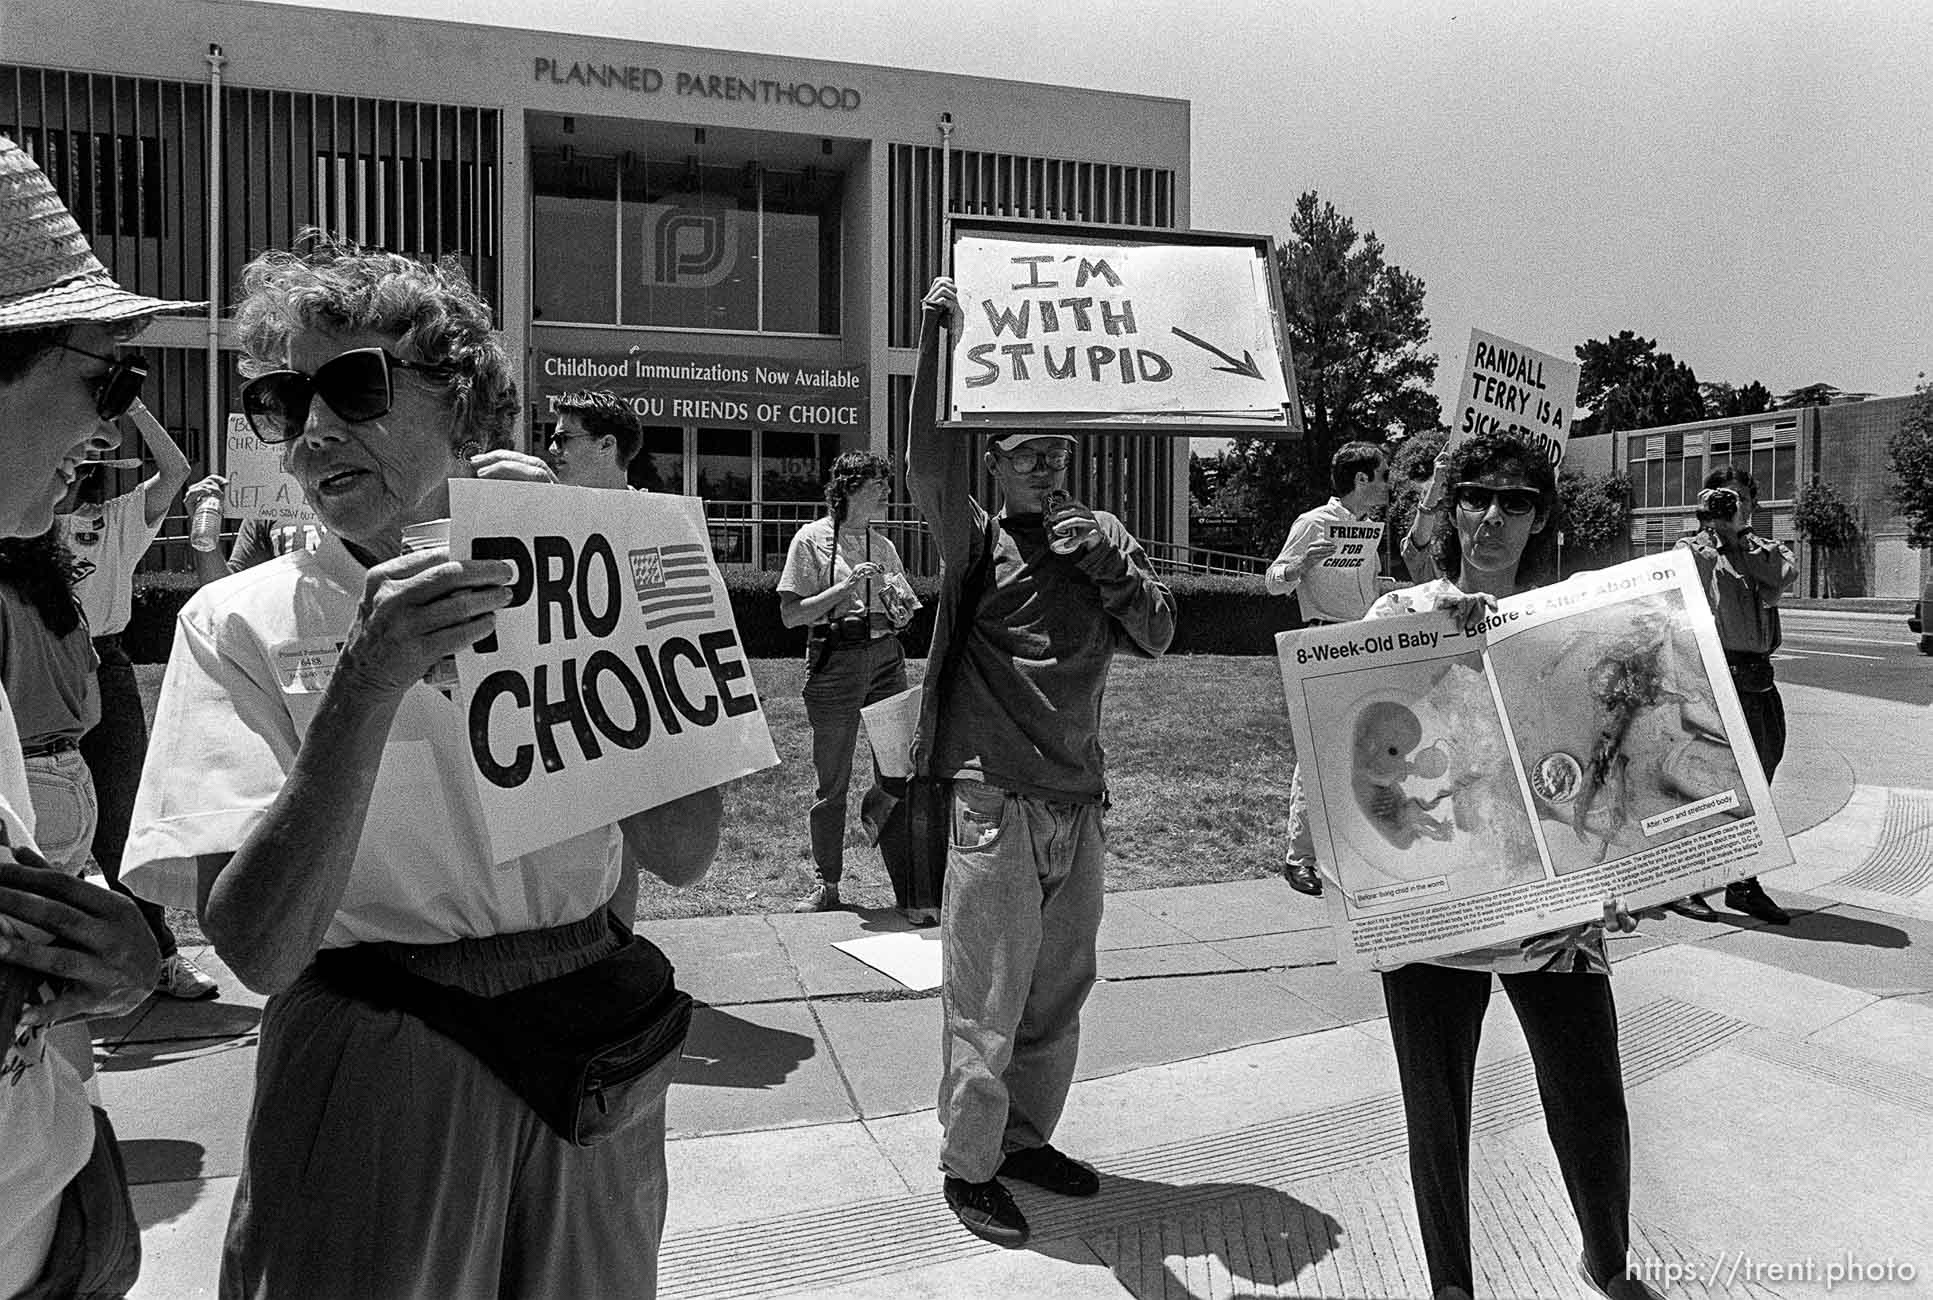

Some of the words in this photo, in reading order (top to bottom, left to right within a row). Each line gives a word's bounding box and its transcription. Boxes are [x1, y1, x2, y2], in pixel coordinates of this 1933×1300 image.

[534, 56, 664, 94] PLANNED
[675, 71, 861, 111] PARENTHOOD
[1011, 255, 1124, 290] I'M
[981, 297, 1138, 339] WITH
[544, 357, 629, 377] Childhood
[636, 360, 749, 383] Immunizations
[755, 367, 790, 385] Now
[794, 369, 860, 388] Available
[965, 343, 1173, 389] STUPID
[1474, 341, 1546, 390] RANDALL
[673, 398, 748, 421] FRIENDS
[756, 404, 782, 422] OF
[789, 405, 858, 425] CHOICE
[1472, 372, 1531, 415] TERRY
[1536, 398, 1551, 424] IS
[1552, 407, 1562, 430] A
[1462, 407, 1500, 435] SICK
[228, 471, 265, 509] GET
[275, 483, 290, 504] A
[1329, 526, 1381, 539] FRIENDS
[1340, 544, 1363, 554] FOR
[1323, 558, 1365, 567] CHOICE
[472, 533, 622, 653] PRO
[1297, 635, 1394, 664] 8-Week-Old
[1399, 631, 1439, 648] Baby
[1464, 610, 1520, 638] Before
[468, 629, 758, 788] CHOICE
[1675, 810, 1686, 819] and
[1687, 800, 1715, 815] stretched
[1715, 795, 1732, 807] body
[1427, 880, 1444, 888] womb
